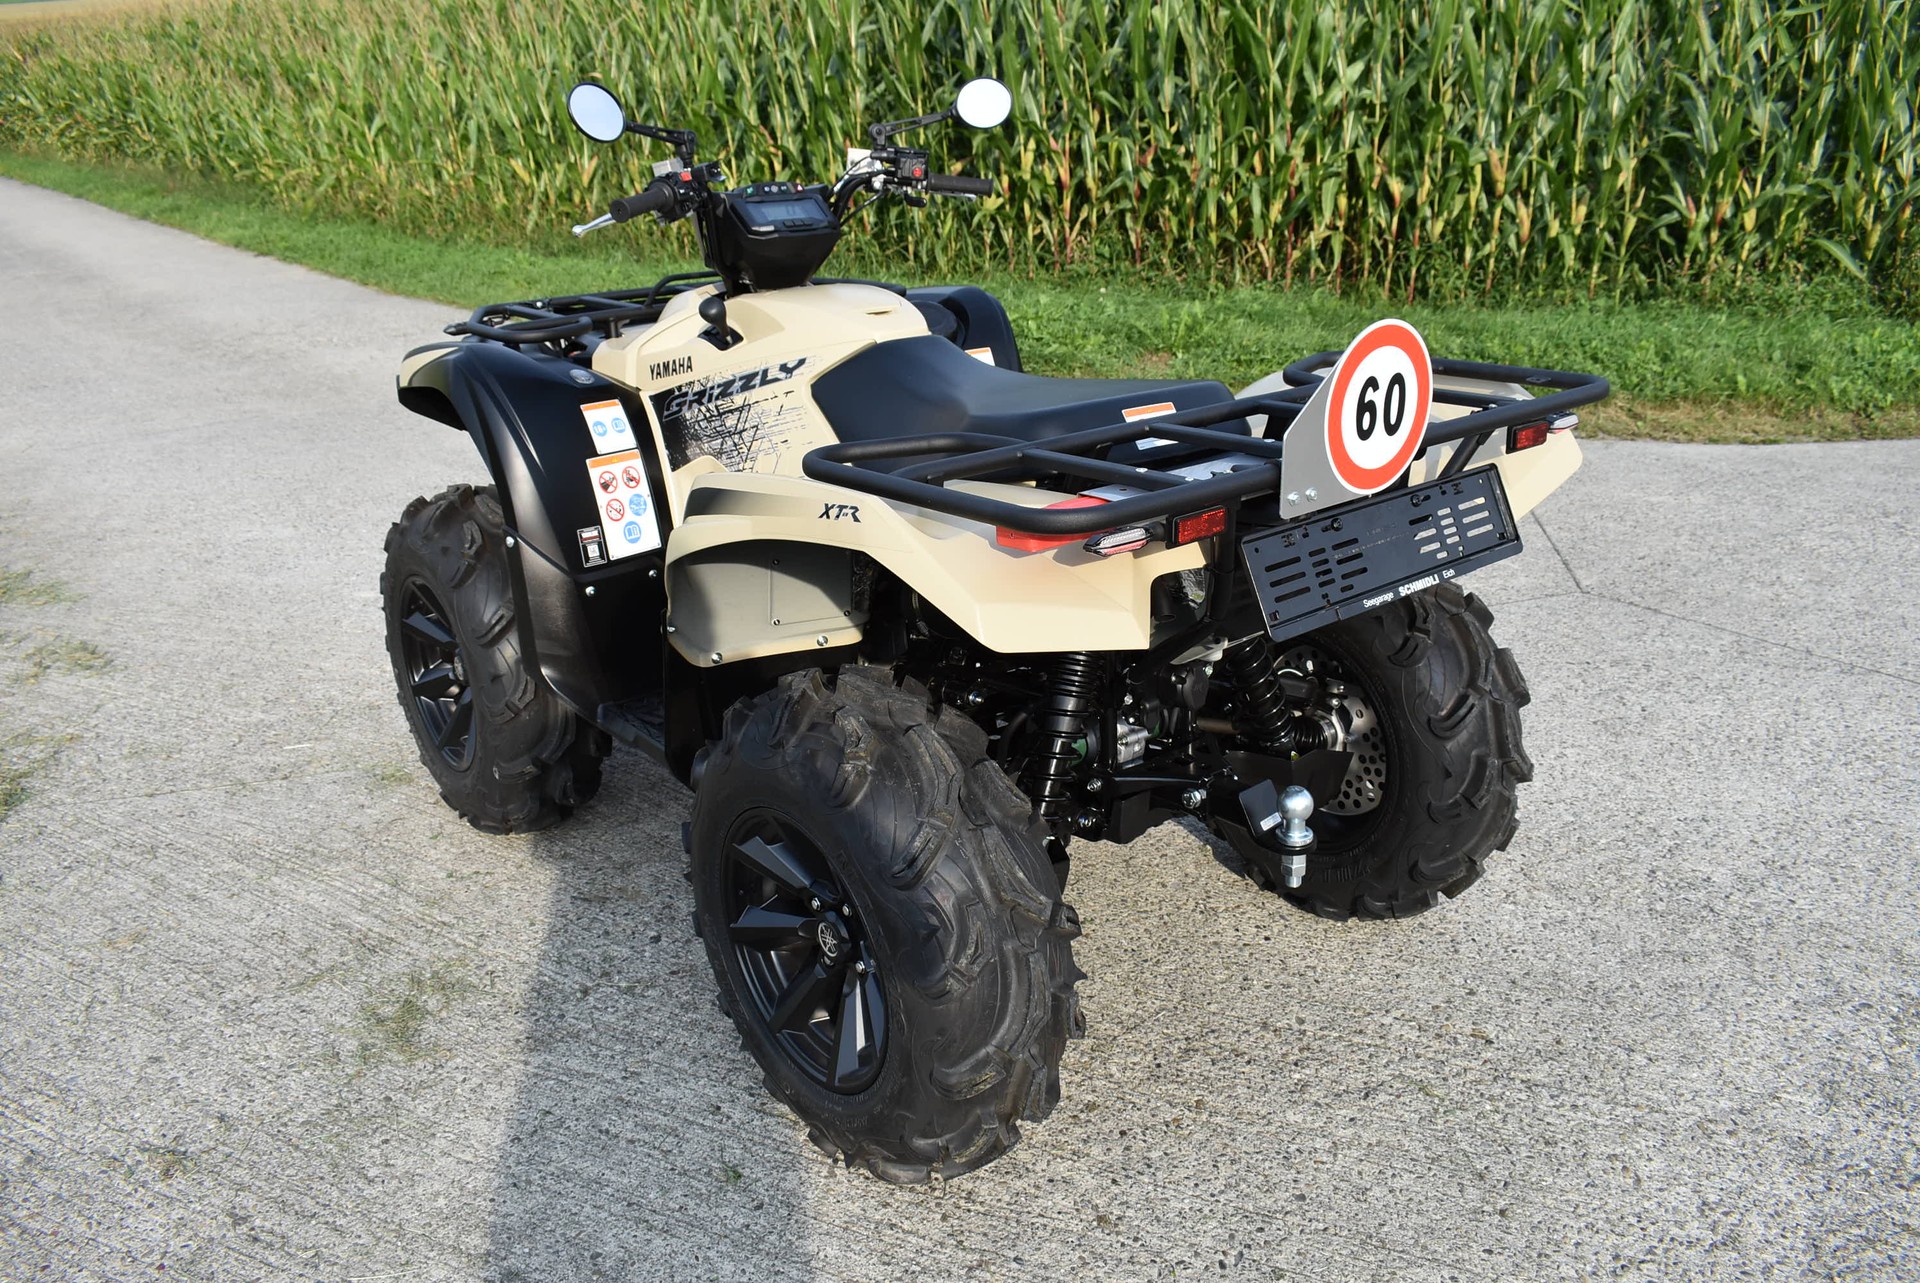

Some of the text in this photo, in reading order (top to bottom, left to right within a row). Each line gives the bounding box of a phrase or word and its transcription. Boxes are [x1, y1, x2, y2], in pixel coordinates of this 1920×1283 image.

[649, 355, 693, 381] YAMAHA
[663, 357, 807, 421] GRIZZLY
[1356, 372, 1406, 441] 60
[1363, 568, 1456, 608] Seegarage SCHMIDLI Eich
